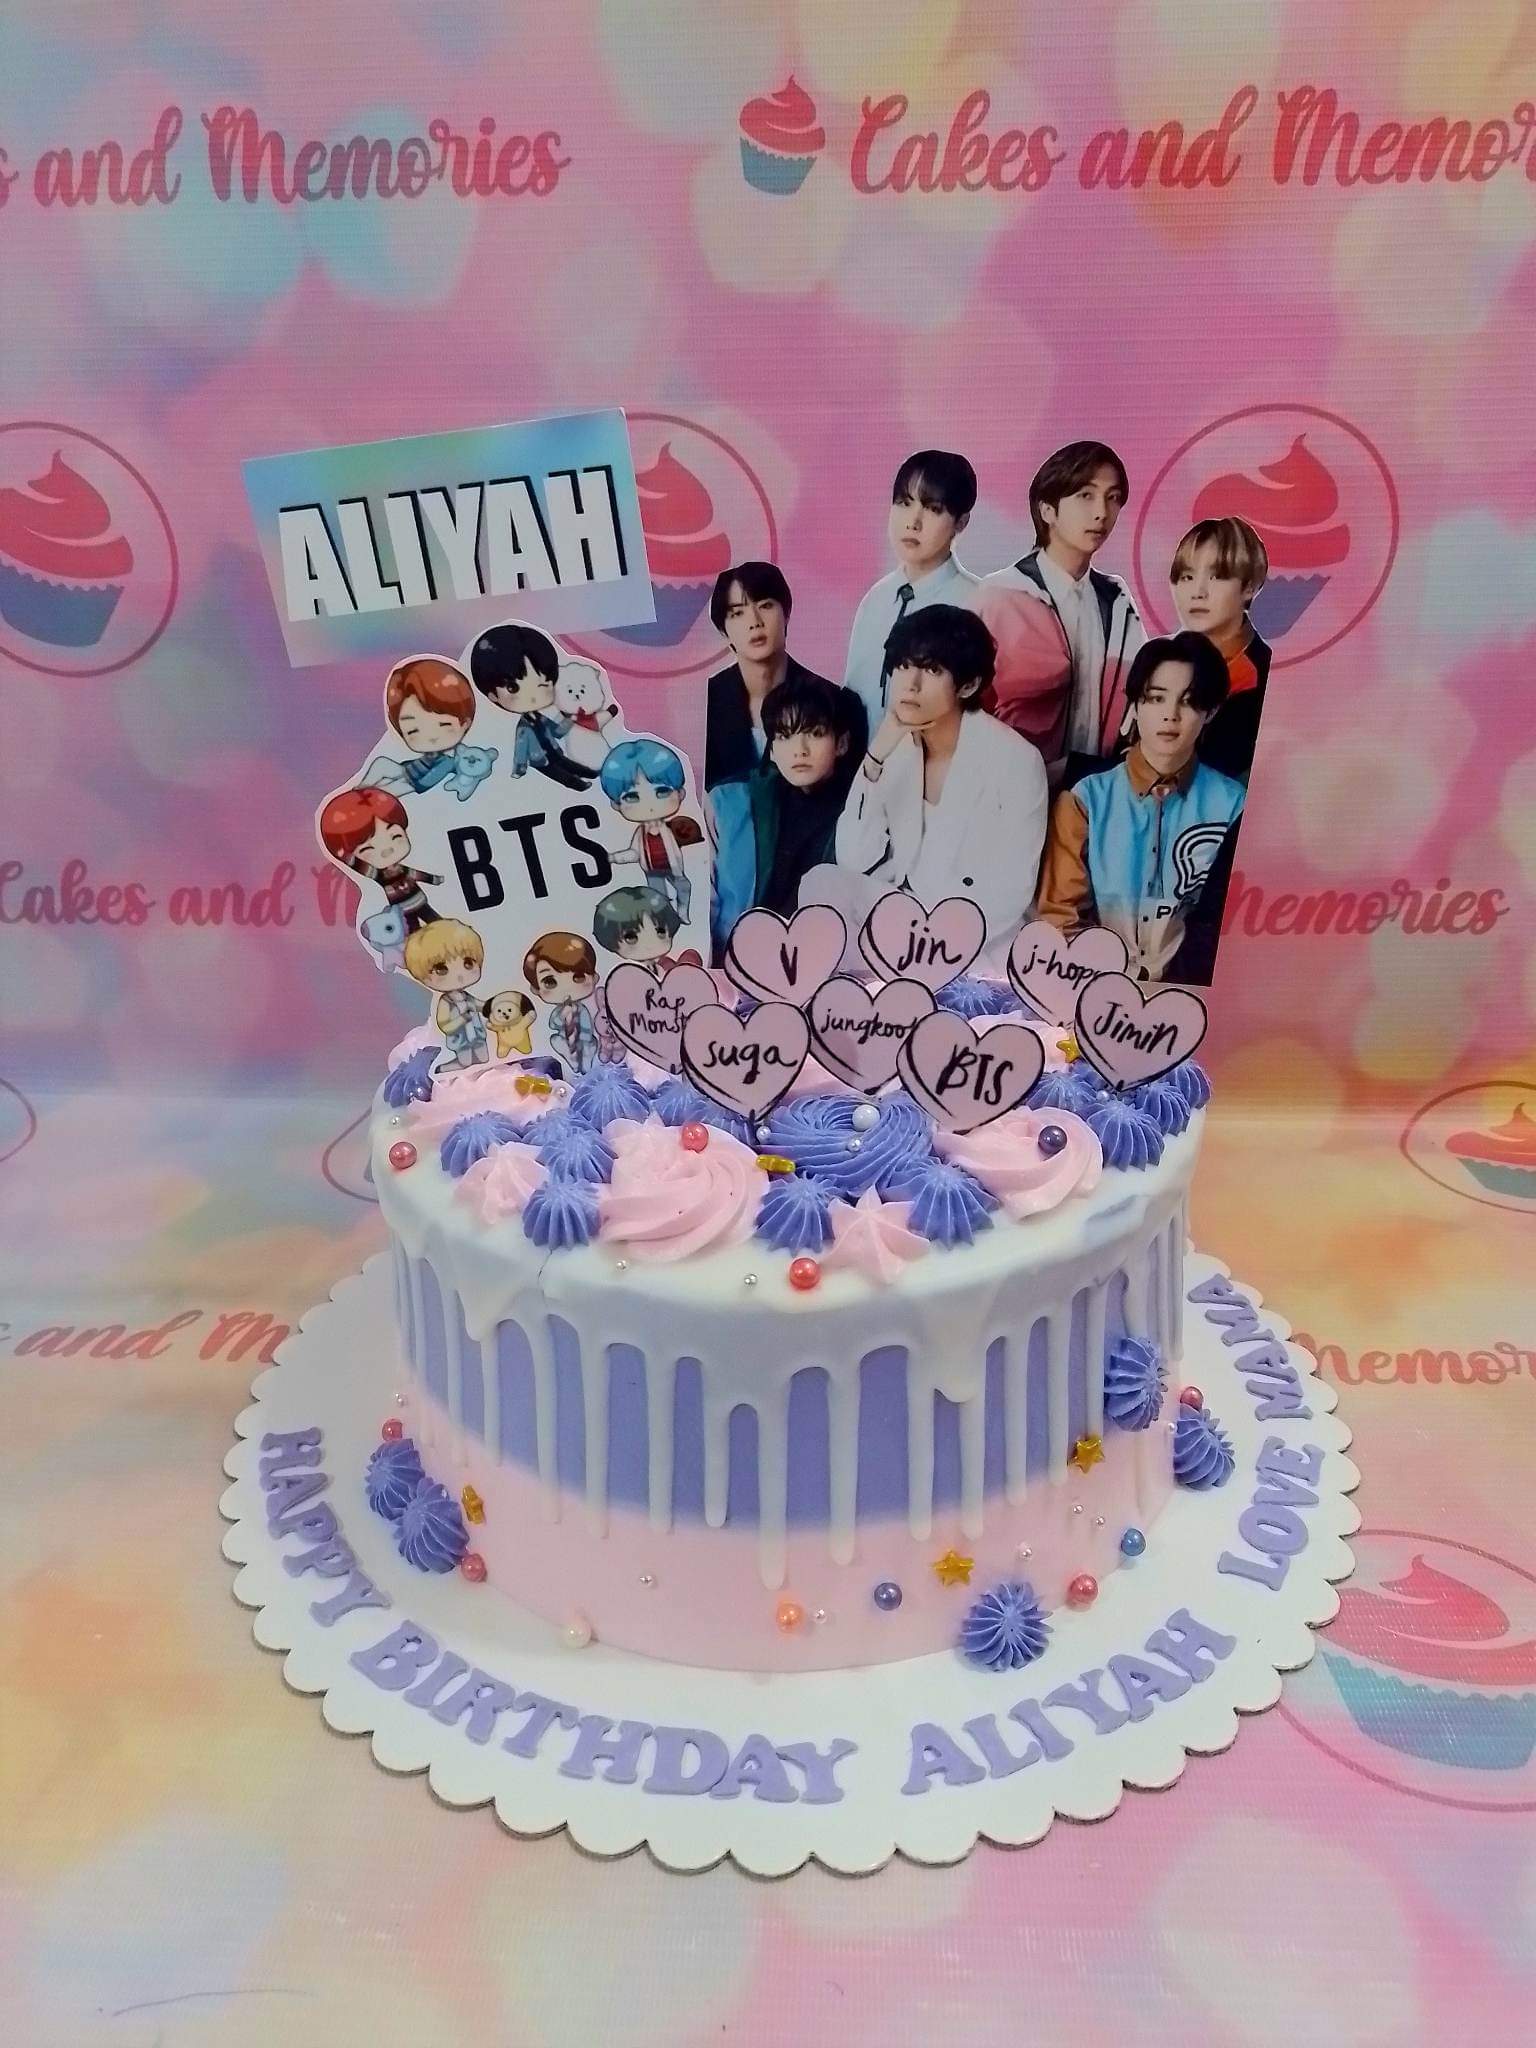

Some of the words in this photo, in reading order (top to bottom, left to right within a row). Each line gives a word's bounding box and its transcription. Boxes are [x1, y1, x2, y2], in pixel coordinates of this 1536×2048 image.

[34, 105, 183, 208] and
[200, 105, 572, 204] Memories
[849, 89, 1065, 196] Cakes
[1078, 84, 1260, 192] and
[278, 464, 628, 622] ALIYAH
[168, 861, 296, 927] and
[447, 804, 613, 912] BTS
[897, 920, 962, 971] jin
[1022, 945, 1101, 990] j-hop
[934, 1044, 1014, 1106] BTS
[13, 1309, 204, 1360] and
[1187, 1272, 1313, 1422] MAMA
[260, 1426, 392, 1627] HAPPY
[1217, 1435, 1326, 1592] LOVE
[350, 1619, 858, 1805] BIRTHDAY
[901, 1607, 1237, 1796] ALIYAH
